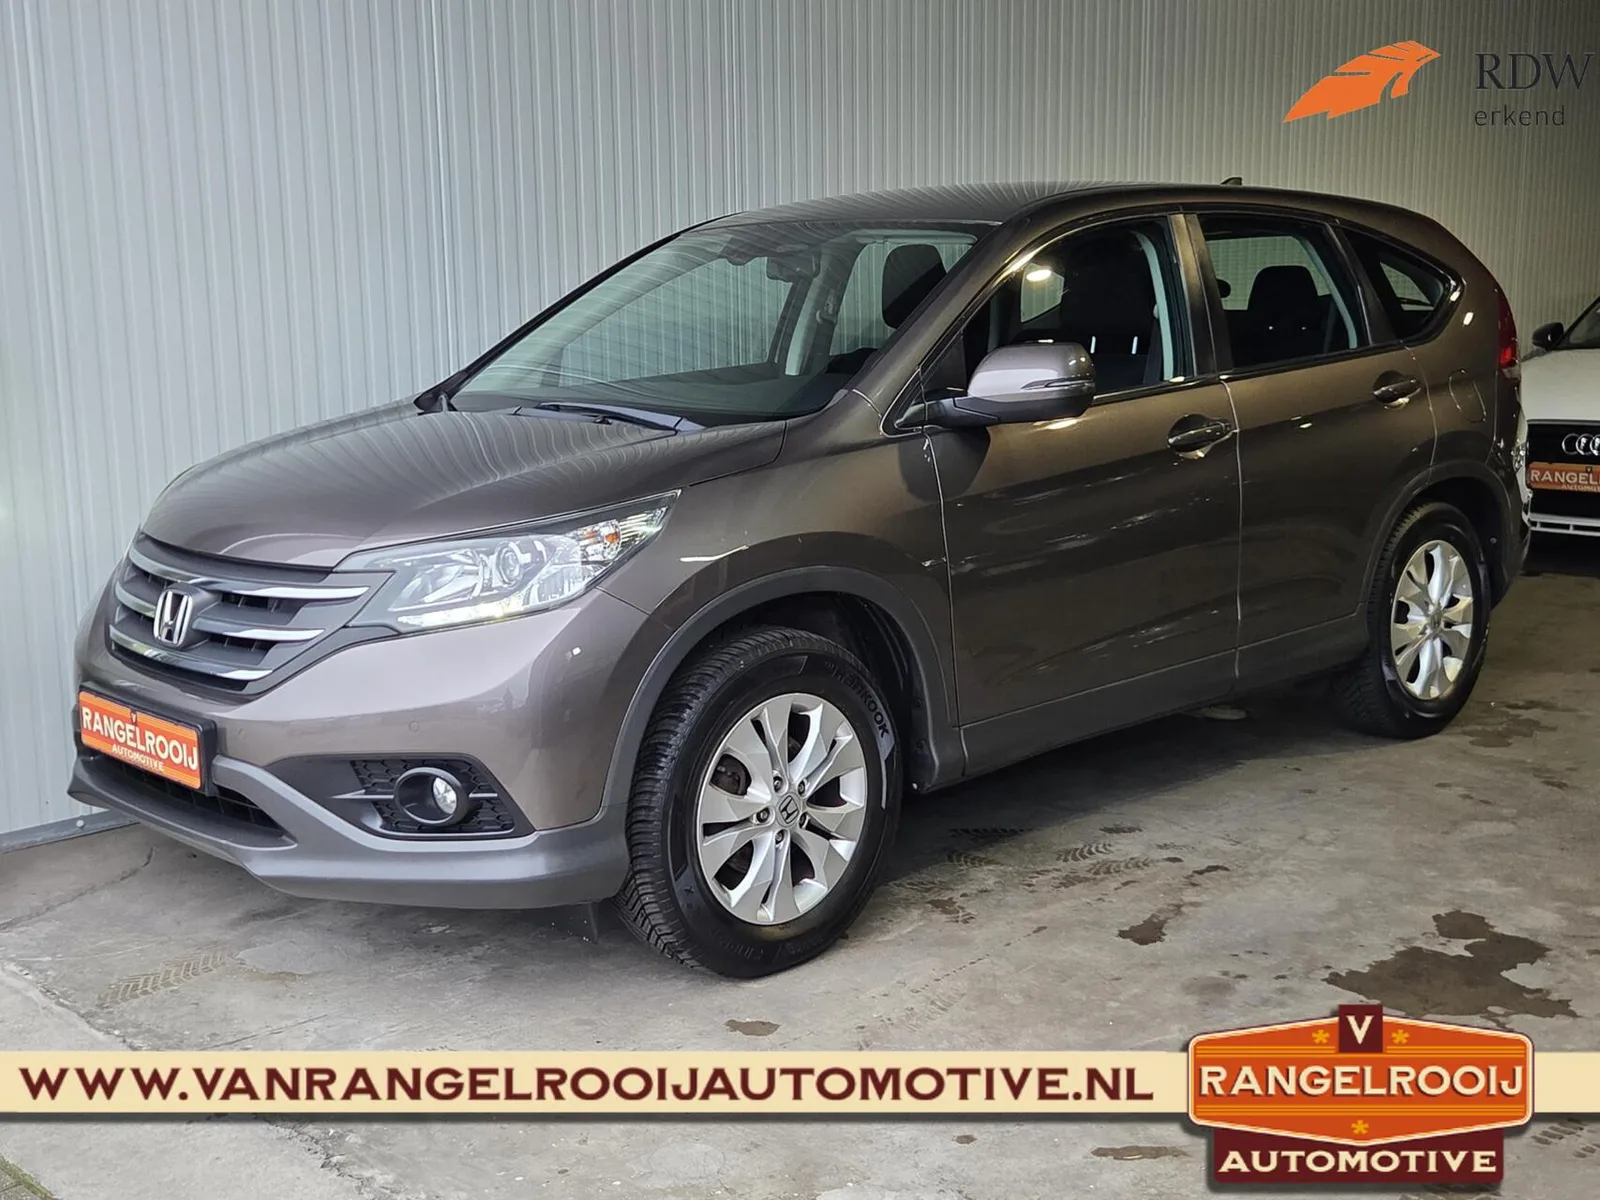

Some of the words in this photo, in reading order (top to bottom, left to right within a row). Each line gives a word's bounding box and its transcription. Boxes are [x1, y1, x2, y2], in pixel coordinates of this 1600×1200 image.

[1530, 470, 1600, 485] RANGEL
[82, 706, 198, 771] RANGELROOIJ
[111, 743, 165, 772] AUTOMOTIVE
